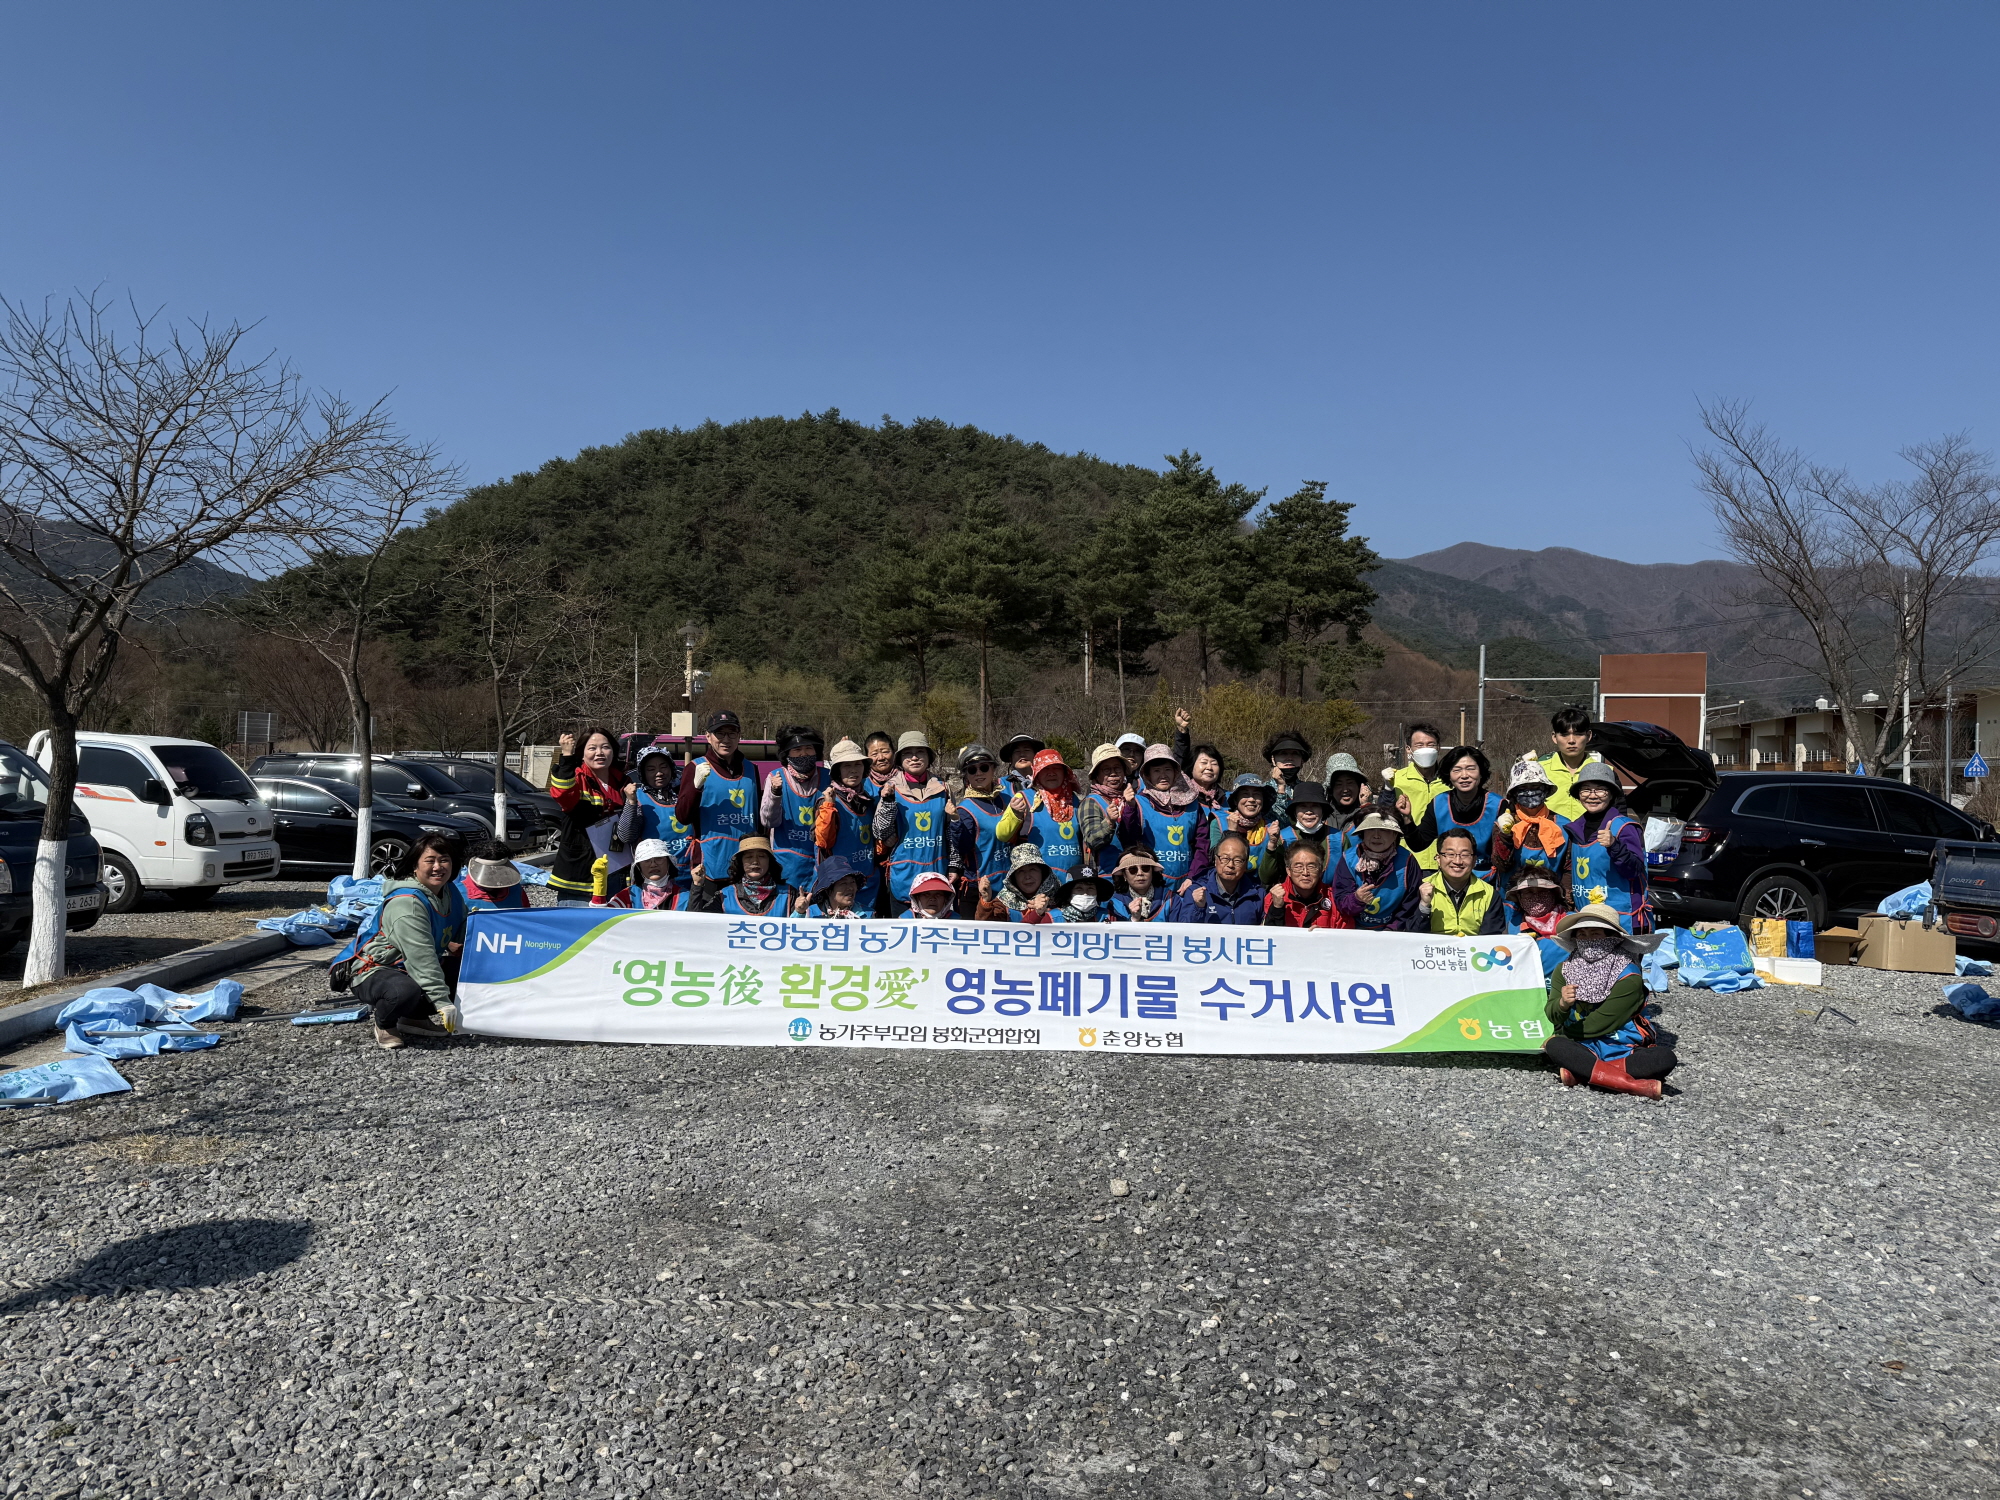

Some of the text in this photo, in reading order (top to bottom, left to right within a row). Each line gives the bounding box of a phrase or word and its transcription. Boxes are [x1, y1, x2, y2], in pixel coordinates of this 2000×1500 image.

[788, 829, 814, 842] 춘양
[65, 895, 97, 910] 6소 2631
[475, 931, 523, 955] NH
[524, 940, 562, 951] NongHyup
[727, 921, 1277, 966] 춘양농협 농가주부모임 희망드림 봉사단
[1424, 945, 1467, 958] 함께하는
[1411, 959, 1467, 972] 100년 농협
[944, 967, 1179, 1020] 영농폐기물
[1199, 977, 1396, 1027] 수거사업
[818, 1023, 1041, 1045] 농가주부모임 봉화군연합회
[1101, 1029, 1184, 1049] 춘양농협
[1488, 1018, 1545, 1040] 농협
